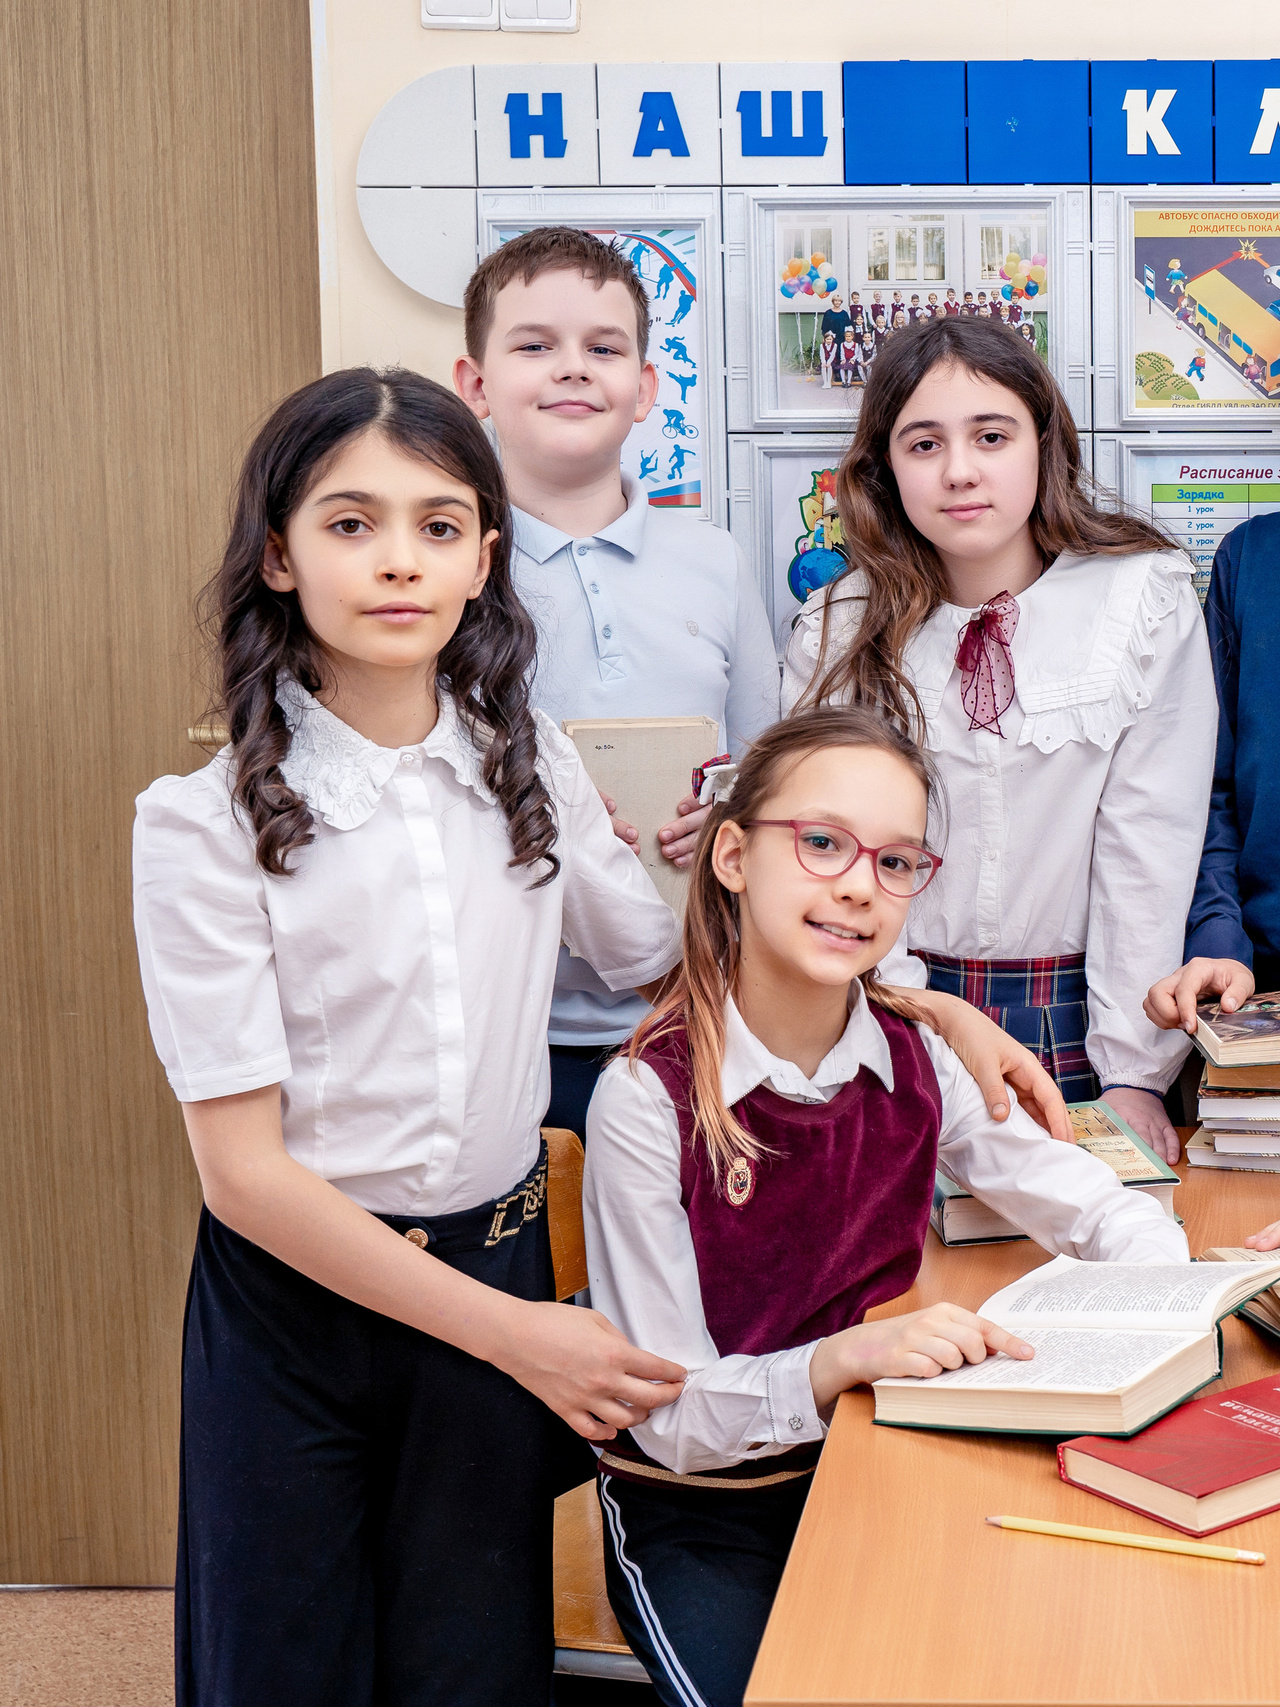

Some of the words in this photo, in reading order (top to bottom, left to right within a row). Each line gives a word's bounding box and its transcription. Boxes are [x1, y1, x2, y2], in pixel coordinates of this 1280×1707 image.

[504, 90, 828, 158] НАШ
[1158, 212, 1199, 220] АВТОБУС
[1200, 212, 1239, 220] ОПАСНО
[1188, 224, 1246, 234] ДОЖДИТЕСЬ
[1248, 224, 1273, 232] ПОКА
[1179, 465, 1274, 479] Расписание
[1176, 489, 1225, 502] Зарядка
[1196, 506, 1214, 515] урок
[1196, 522, 1214, 531] урок
[1196, 538, 1214, 546] урок
[1196, 570, 1211, 578] уро
